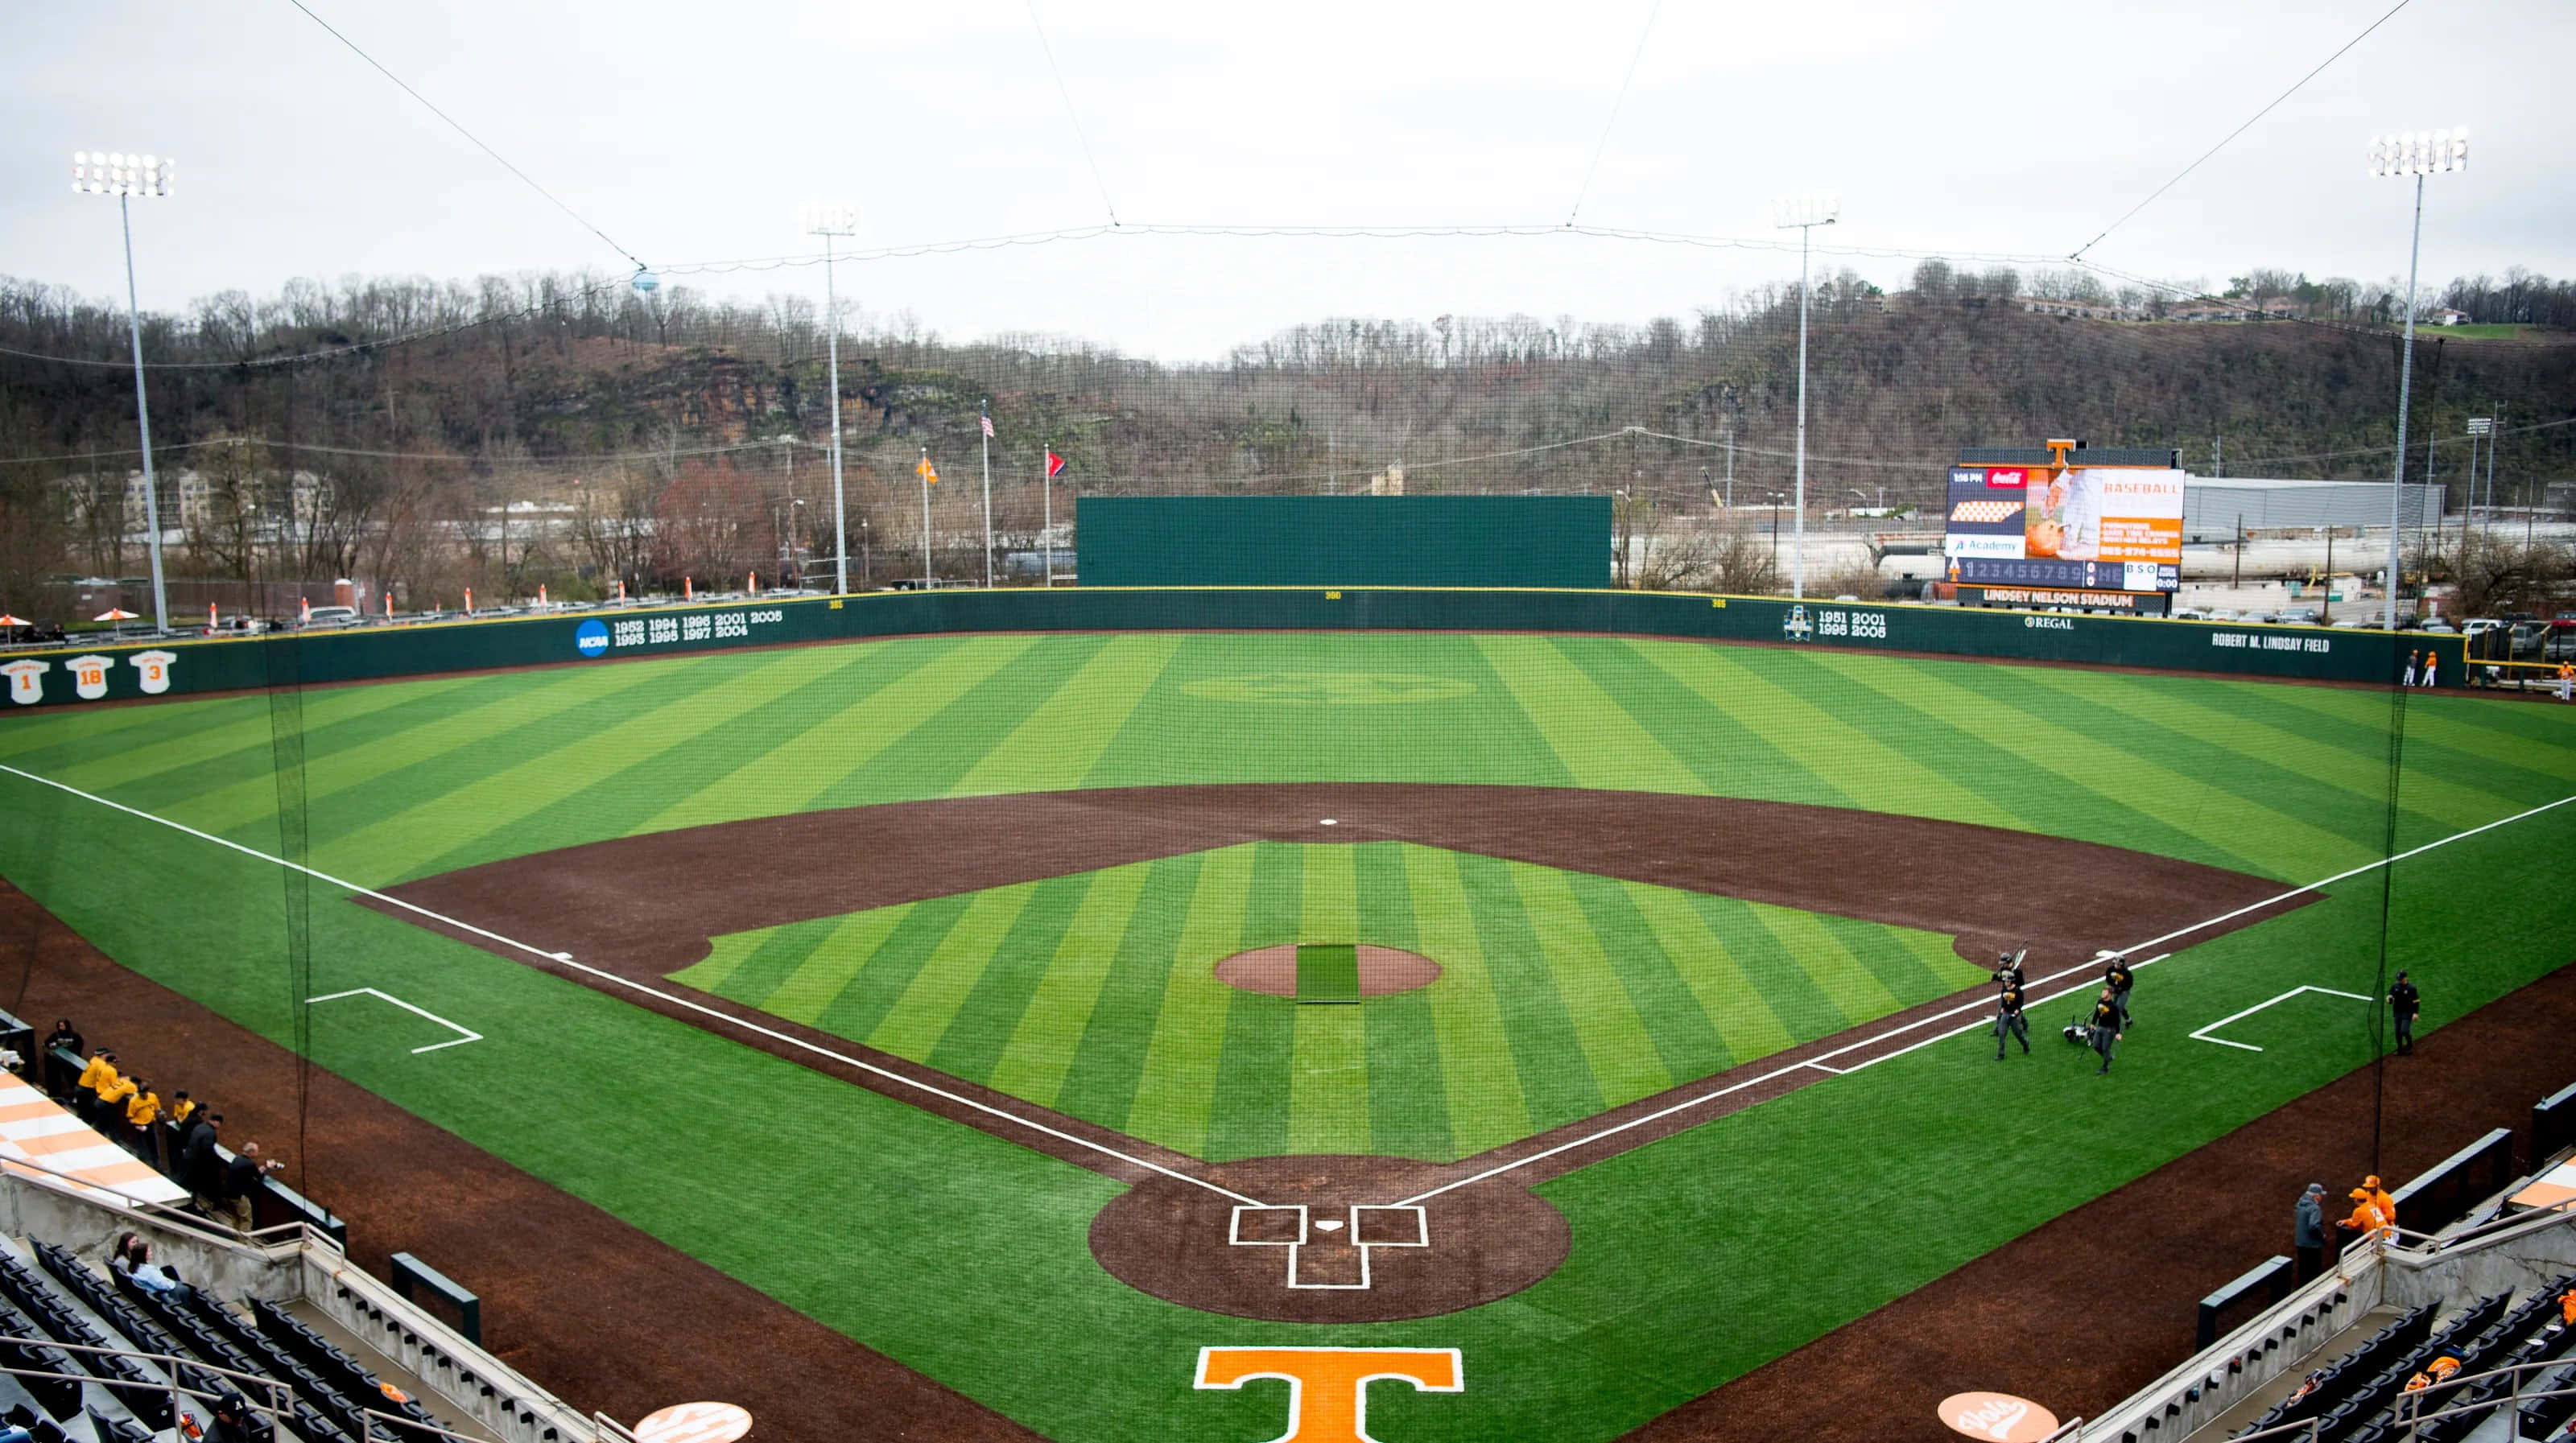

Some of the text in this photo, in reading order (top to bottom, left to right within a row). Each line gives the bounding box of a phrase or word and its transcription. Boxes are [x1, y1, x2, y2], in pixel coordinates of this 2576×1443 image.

[1970, 473, 1983, 483] PM
[2103, 483, 2178, 494] BASEBALL
[1970, 540, 2016, 552] Academy
[1966, 561, 2081, 579] 1 2 3 4 5 6 7 8 9
[2127, 565, 2133, 573] B
[2137, 565, 2144, 573] S
[2157, 579, 2178, 588] 0:00
[1984, 588, 2134, 607] LINDSEY NELSON STADIUM
[614, 620, 645, 634] 1952
[649, 618, 678, 631] 1994
[715, 612, 746, 626] 2001
[1818, 610, 1885, 626] 1951 2001
[2035, 616, 2074, 629] REGAL
[615, 625, 748, 647] 1993 1995 1997 2004
[1818, 623, 1847, 636] 1995
[579, 636, 609, 649] NCAA
[2212, 633, 2330, 653] ROBERT M. LINDSAY FIELD
[80, 670, 101, 686] 18
[149, 665, 161, 680] 3
[21, 674, 31, 690] 1
[1193, 1346, 1464, 1443] T
[1958, 1401, 2028, 1439] Vols
